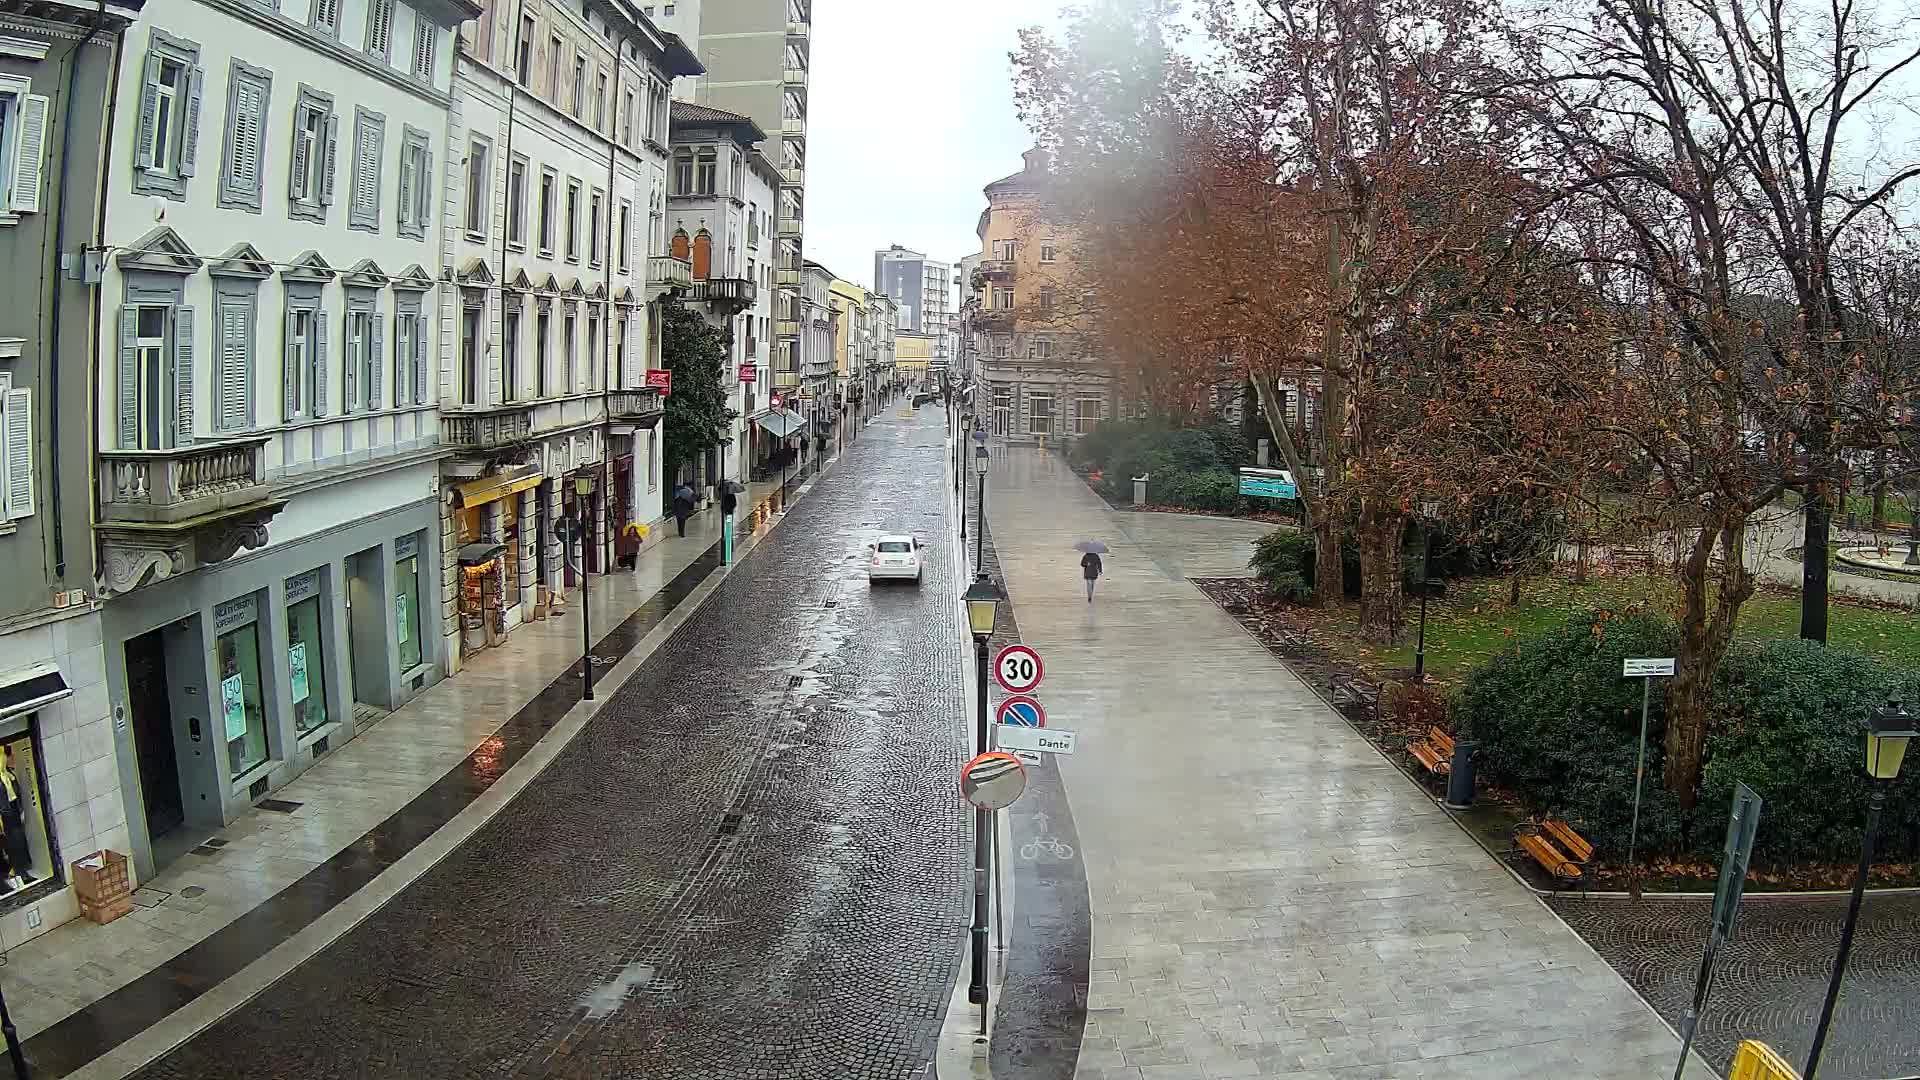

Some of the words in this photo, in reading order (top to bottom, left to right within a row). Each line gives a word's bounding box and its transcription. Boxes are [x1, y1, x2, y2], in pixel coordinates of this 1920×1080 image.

[1006, 658, 1033, 680] 30
[222, 676, 241, 700] 130
[1038, 738, 1070, 749] Dante
